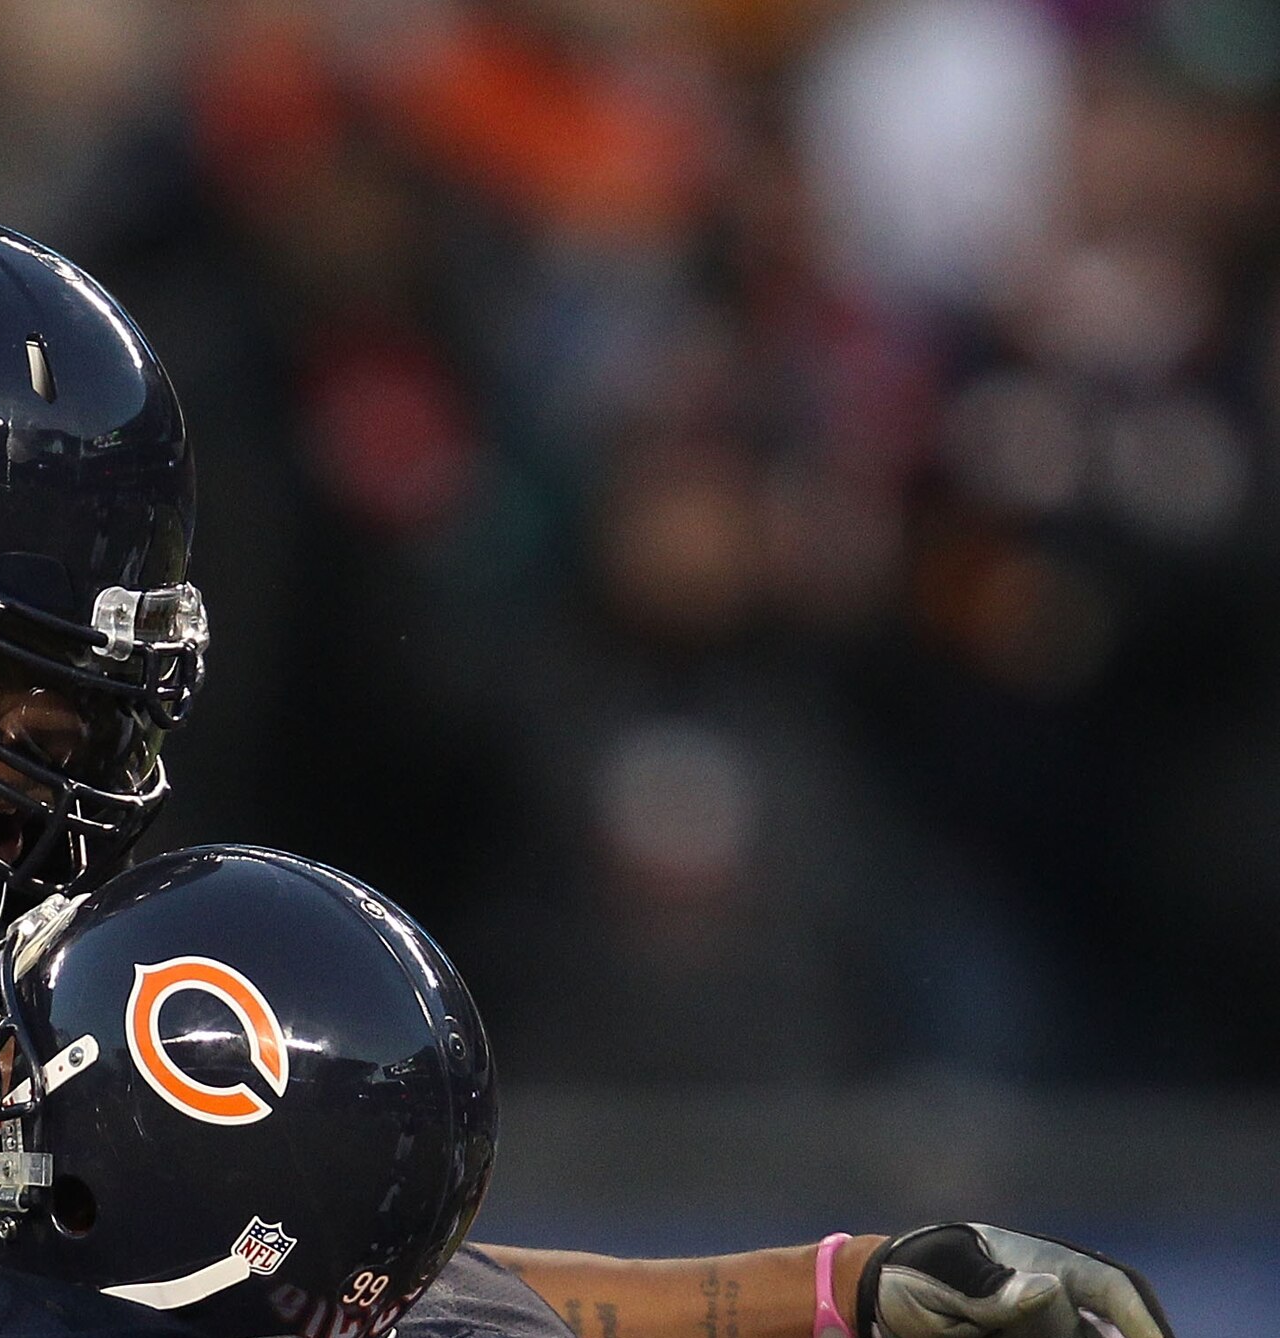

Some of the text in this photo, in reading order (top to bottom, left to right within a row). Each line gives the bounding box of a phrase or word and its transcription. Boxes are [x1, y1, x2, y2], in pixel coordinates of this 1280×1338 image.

[125, 955, 290, 1126] C
[239, 1237, 278, 1268] NFL
[343, 1271, 389, 1307] 99
